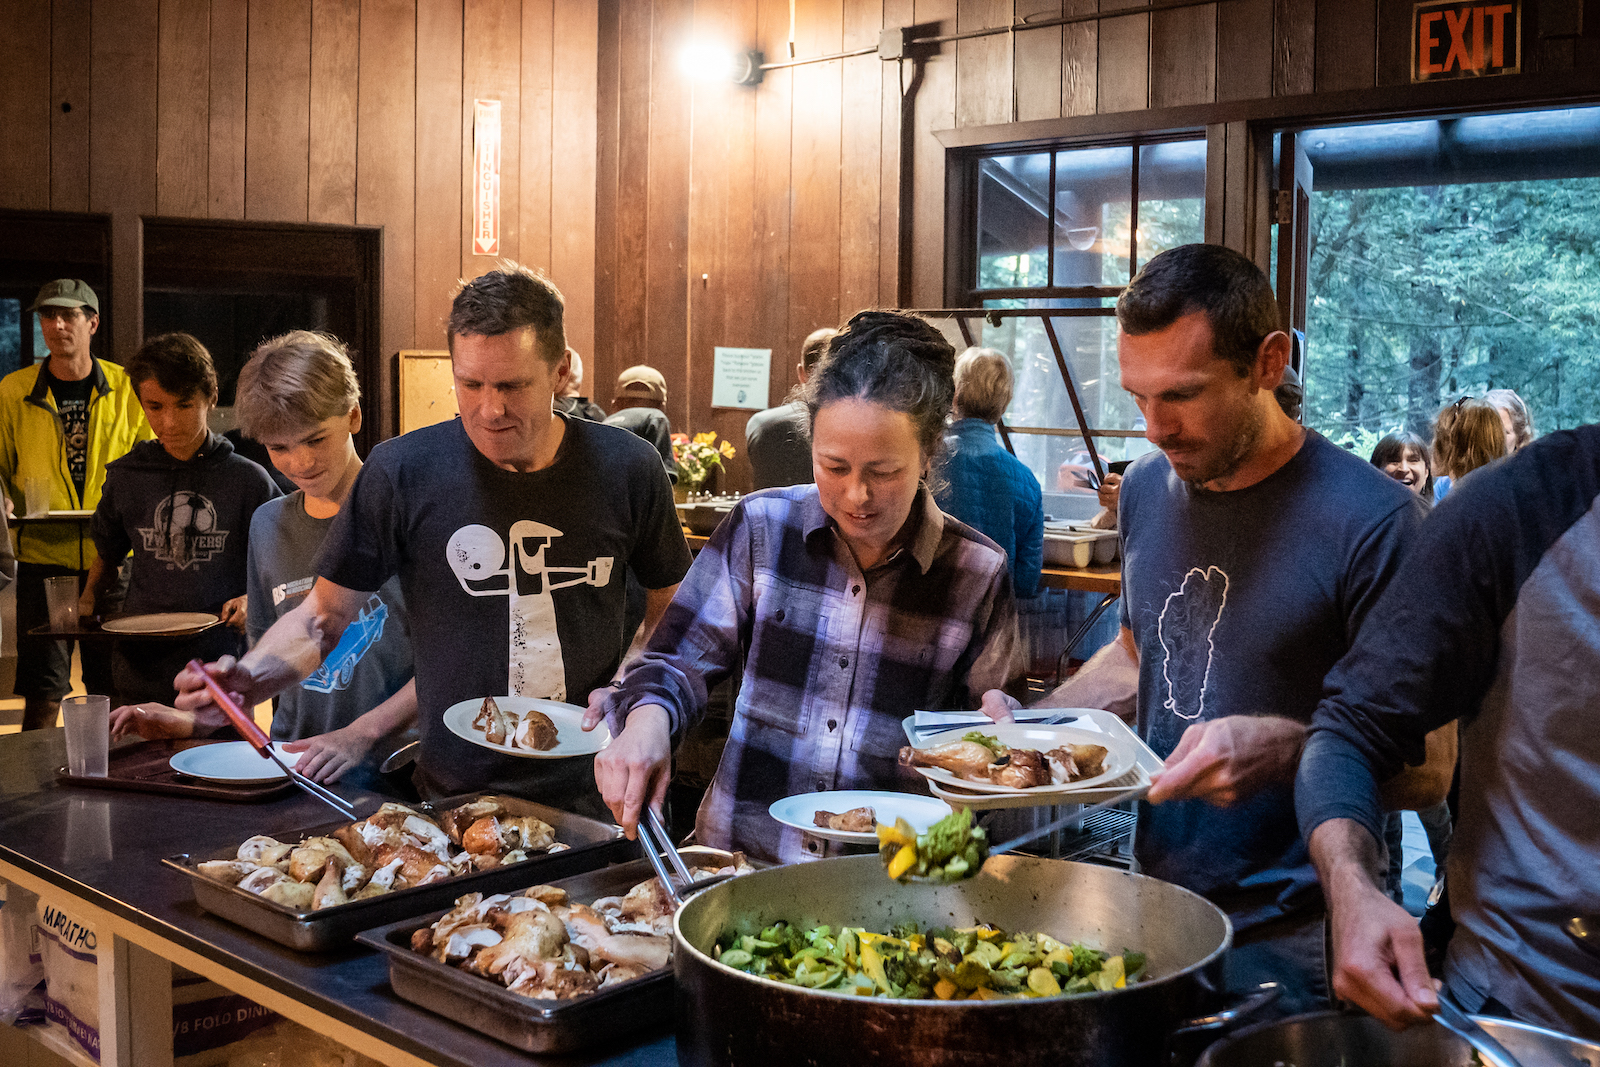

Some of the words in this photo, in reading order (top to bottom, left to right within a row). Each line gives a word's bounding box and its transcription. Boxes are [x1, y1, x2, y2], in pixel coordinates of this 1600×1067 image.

[1420, 4, 1512, 74] EXIT
[43, 904, 97, 950] MARATHO
[194, 1012, 232, 1031] FOLD
